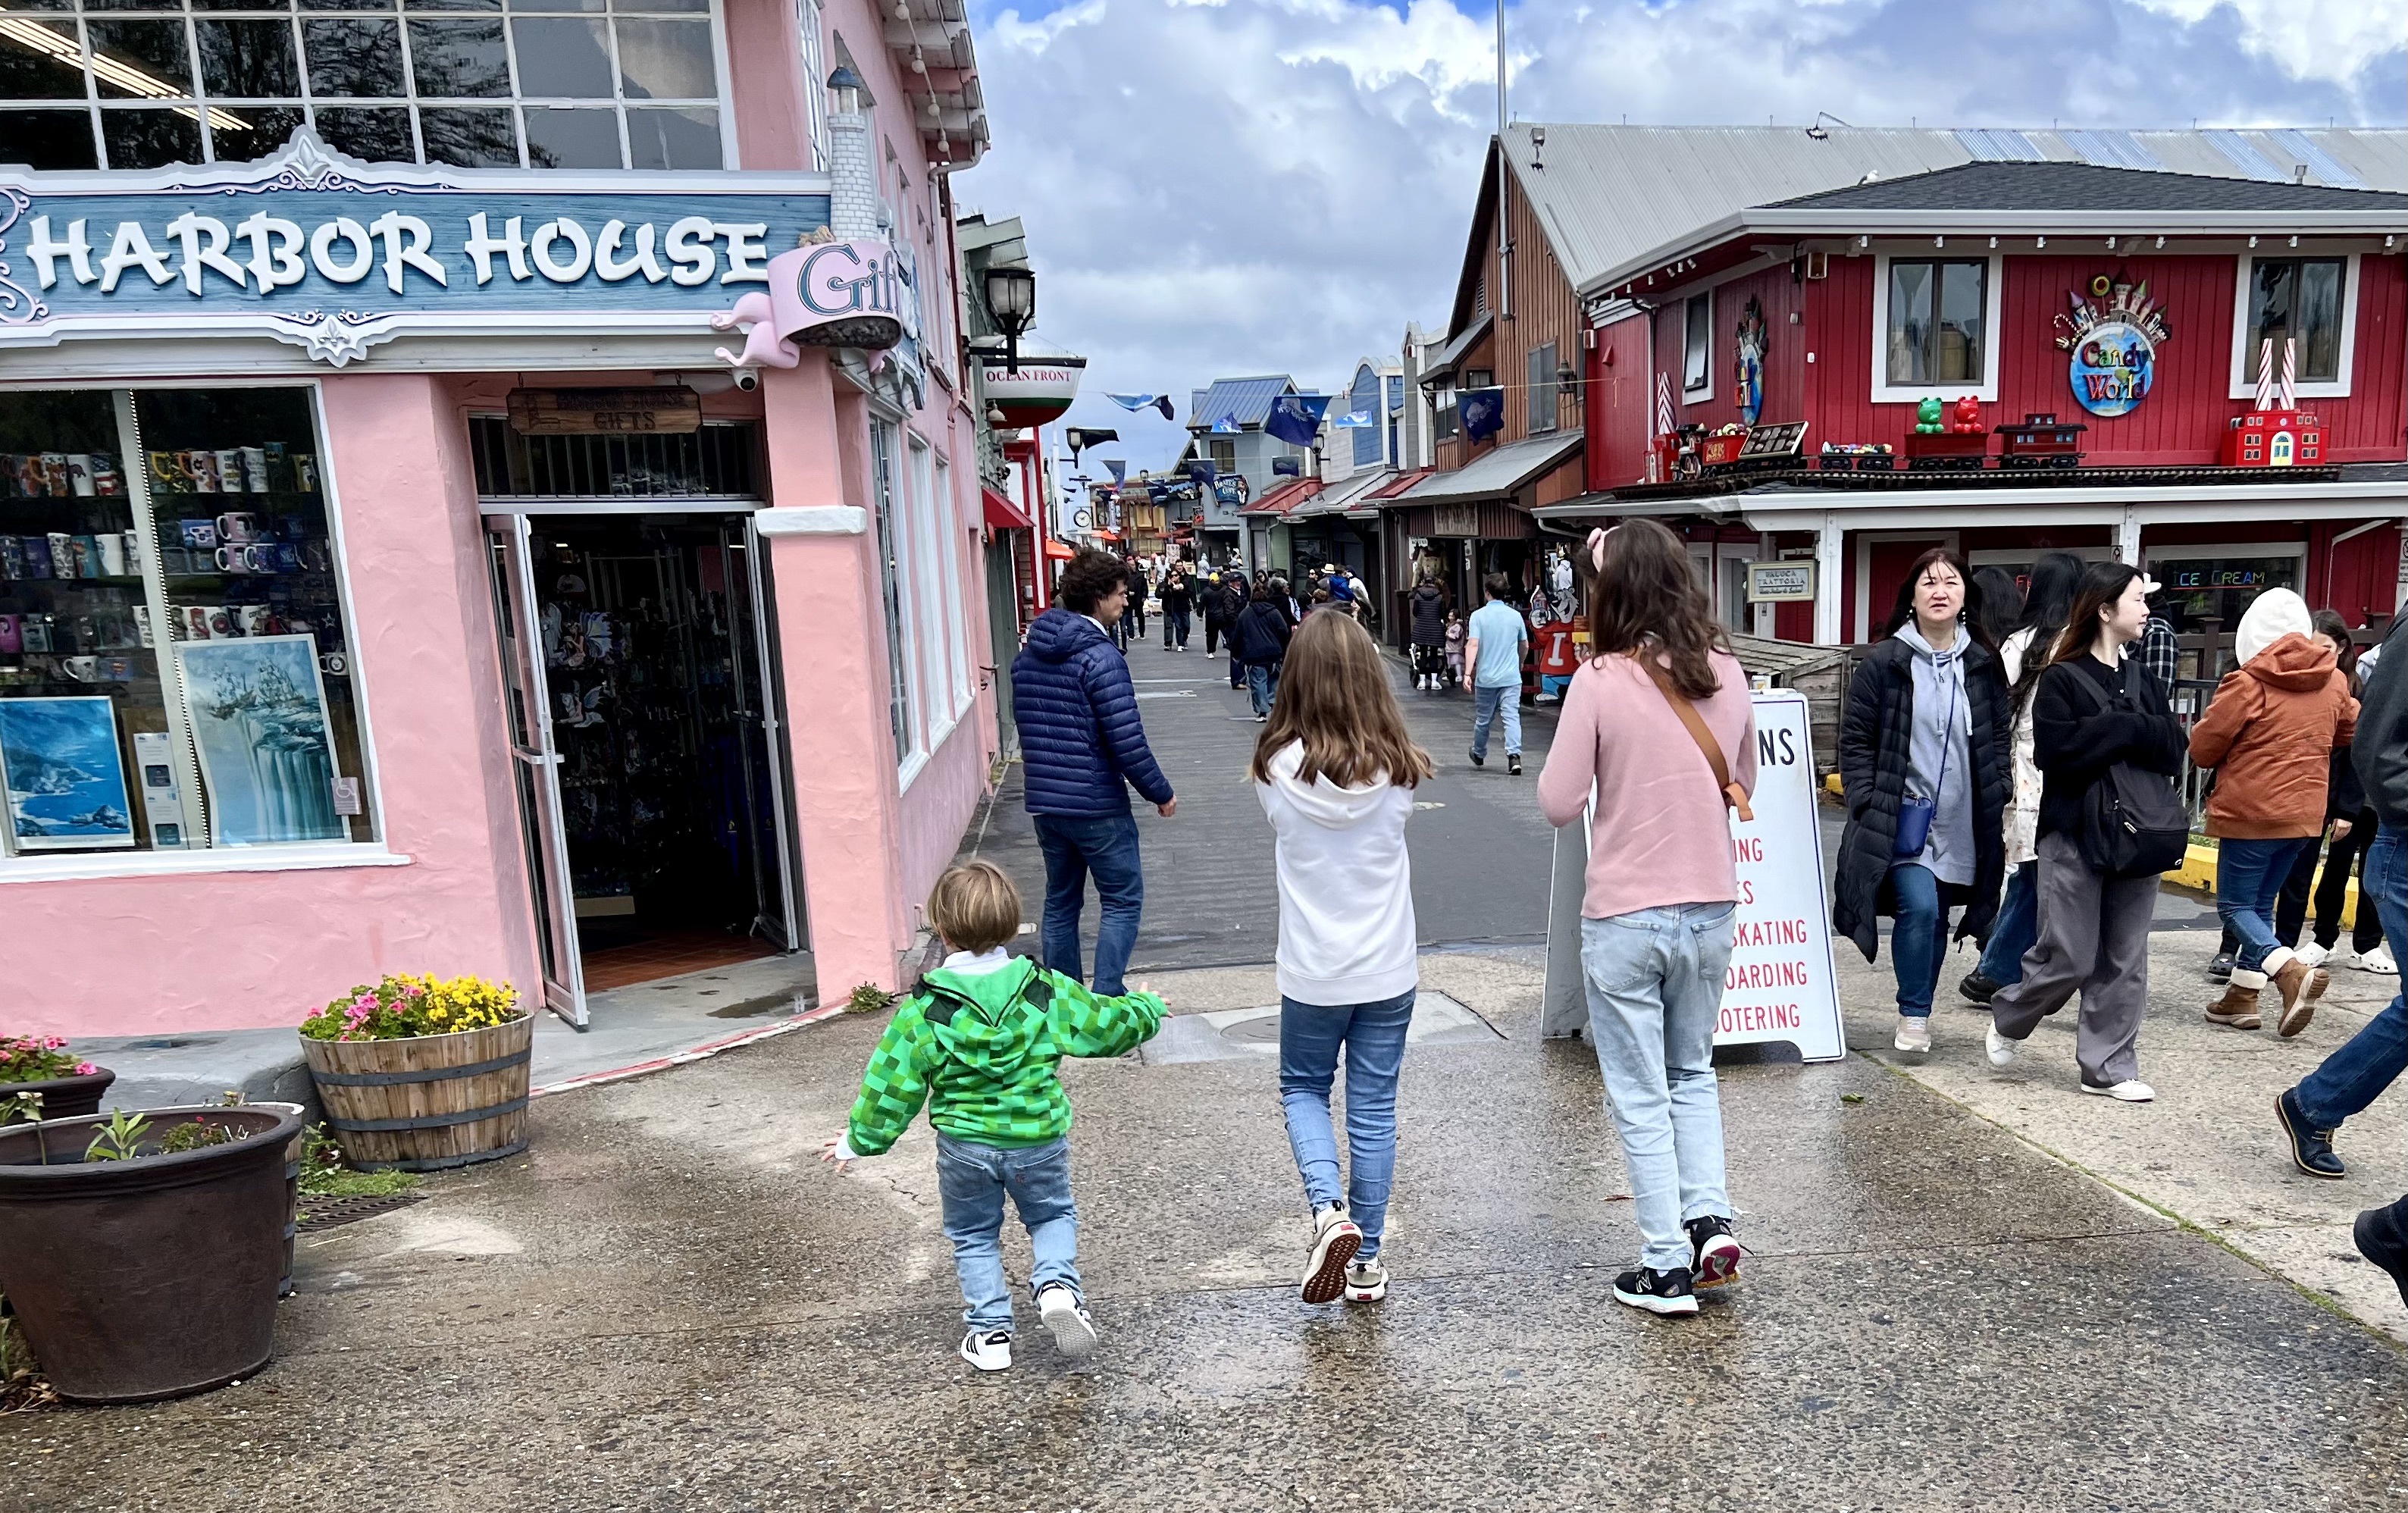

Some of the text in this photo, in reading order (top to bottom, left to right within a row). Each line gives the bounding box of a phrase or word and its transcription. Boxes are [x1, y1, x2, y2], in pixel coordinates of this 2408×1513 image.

[27, 210, 768, 296] HARBOR HOUSE
[797, 244, 899, 316] Gif
[2081, 341, 2150, 374] Candy
[986, 370, 1072, 382] OCEAN FRONT
[2083, 374, 2147, 401] World
[593, 412, 656, 431] GIFTS
[2172, 570, 2265, 586] ICE CREAM
[1714, 1004, 1800, 1033] OTERING
